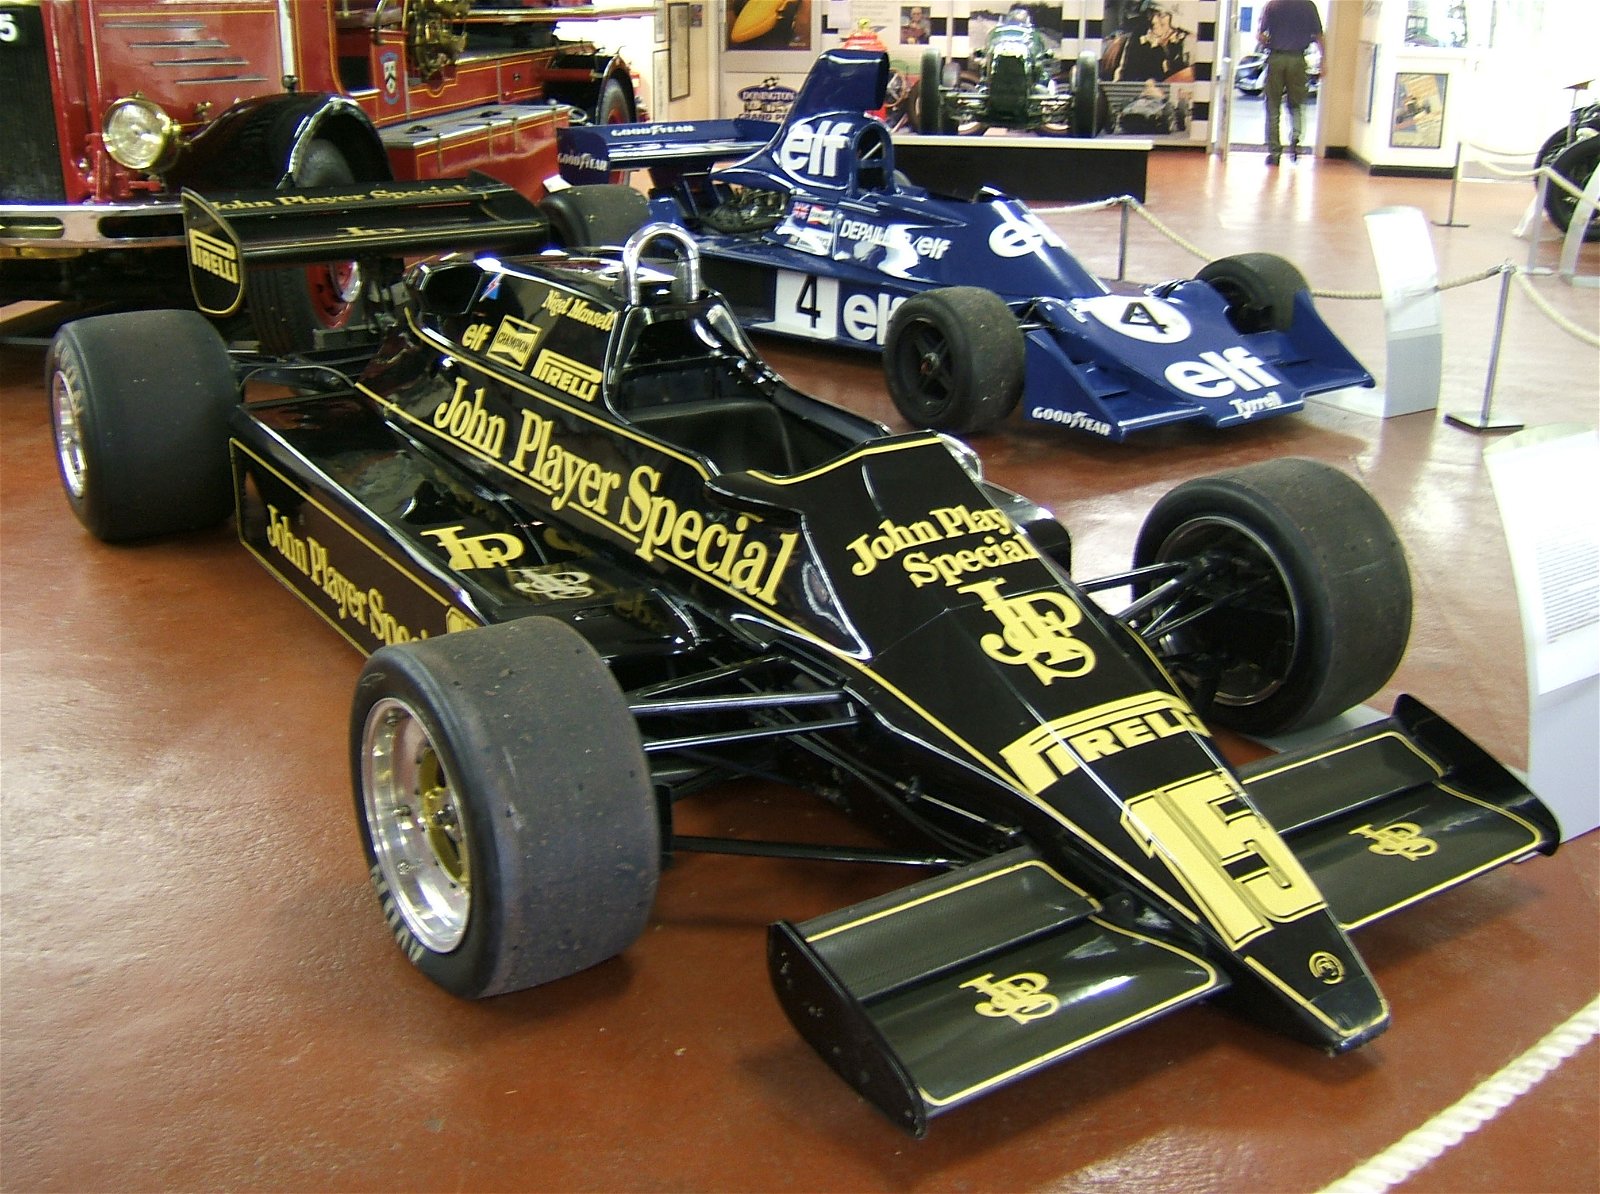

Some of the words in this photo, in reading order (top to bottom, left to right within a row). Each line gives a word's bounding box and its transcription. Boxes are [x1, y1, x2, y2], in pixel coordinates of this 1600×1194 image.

[611, 125, 695, 136] GOODYEAR
[781, 120, 853, 177] elf
[557, 153, 608, 171] GOODYEAR
[211, 200, 275, 210] John
[275, 194, 367, 207] Player
[369, 184, 468, 199] Special
[188, 228, 240, 284] PIRELLI
[541, 289, 574, 317] Nigel
[567, 298, 617, 332] Mansell
[796, 275, 821, 329] 4
[1120, 301, 1170, 334] 4
[461, 323, 493, 351] elf
[496, 331, 531, 354] CHAMPION
[530, 349, 603, 402] PIRELLI
[1164, 346, 1282, 398] elf
[1031, 406, 1111, 436] GOODYEAR
[1228, 391, 1282, 419] Tyrrell
[434, 376, 506, 459] John
[509, 408, 621, 511] Player
[619, 465, 799, 605] Special
[266, 504, 310, 576] John
[306, 536, 368, 620] Player
[846, 518, 943, 577] John
[929, 504, 1012, 536] Play
[902, 532, 1039, 589] Special
[1120, 767, 1328, 952] 15
